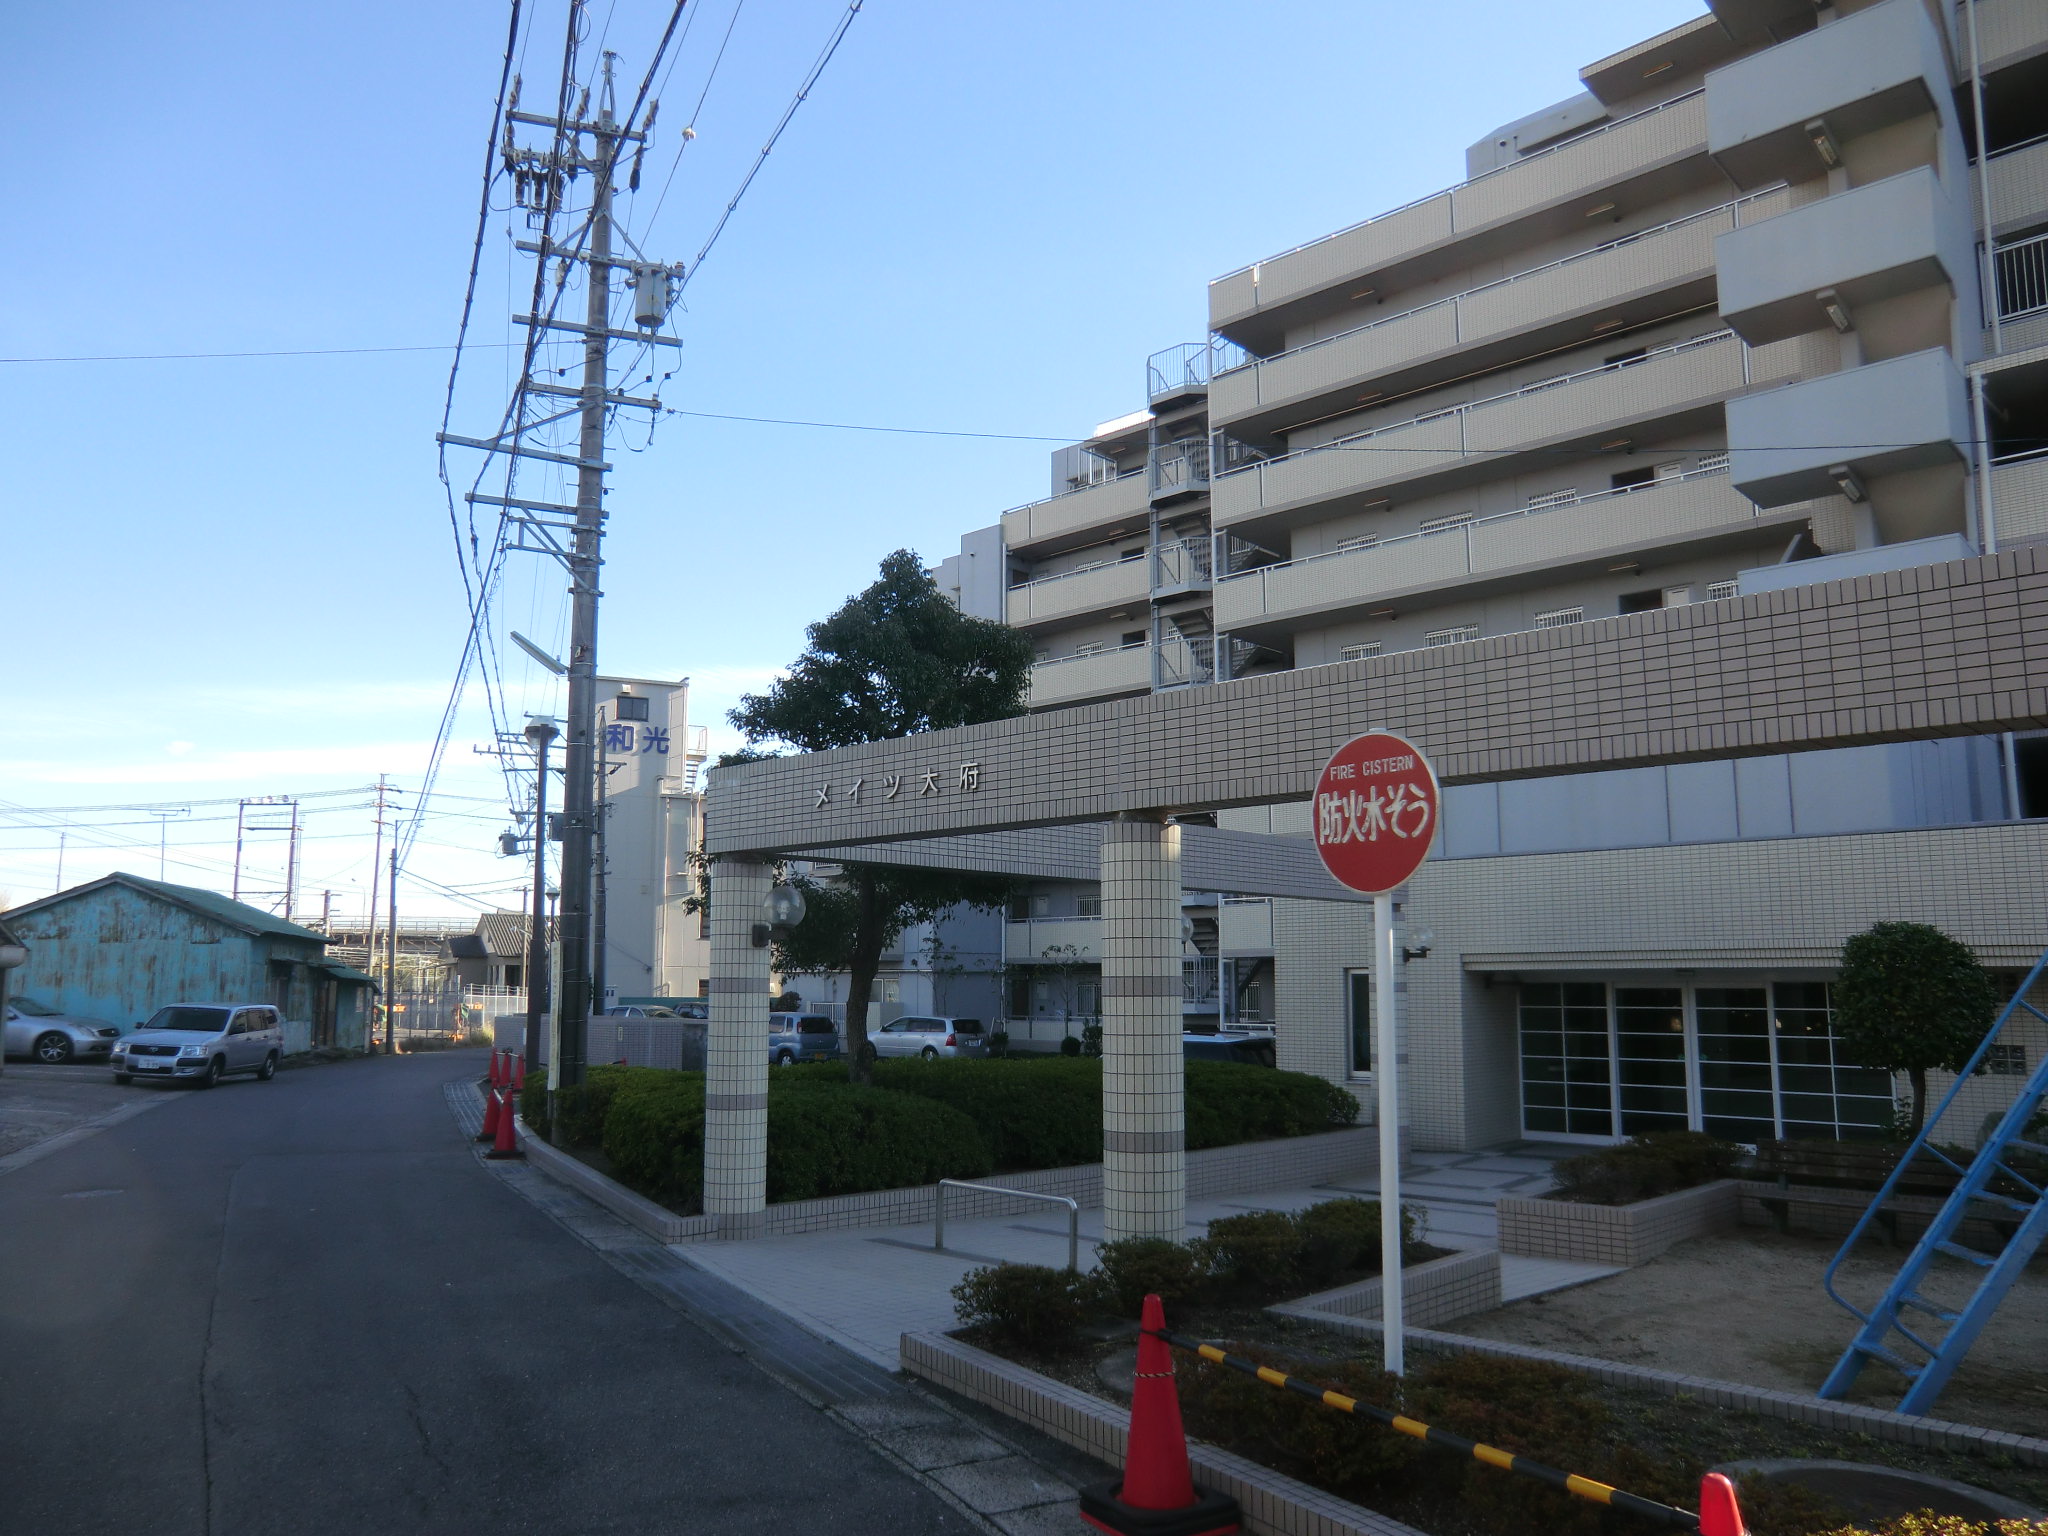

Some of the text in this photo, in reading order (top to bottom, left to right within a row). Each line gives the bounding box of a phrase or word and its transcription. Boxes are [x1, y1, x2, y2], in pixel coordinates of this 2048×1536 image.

[606, 723, 671, 755] 和光
[815, 761, 979, 808] メイツ大府
[1330, 754, 1414, 781] FIRE CISTERN
[1319, 783, 1430, 846] 防火水そう
